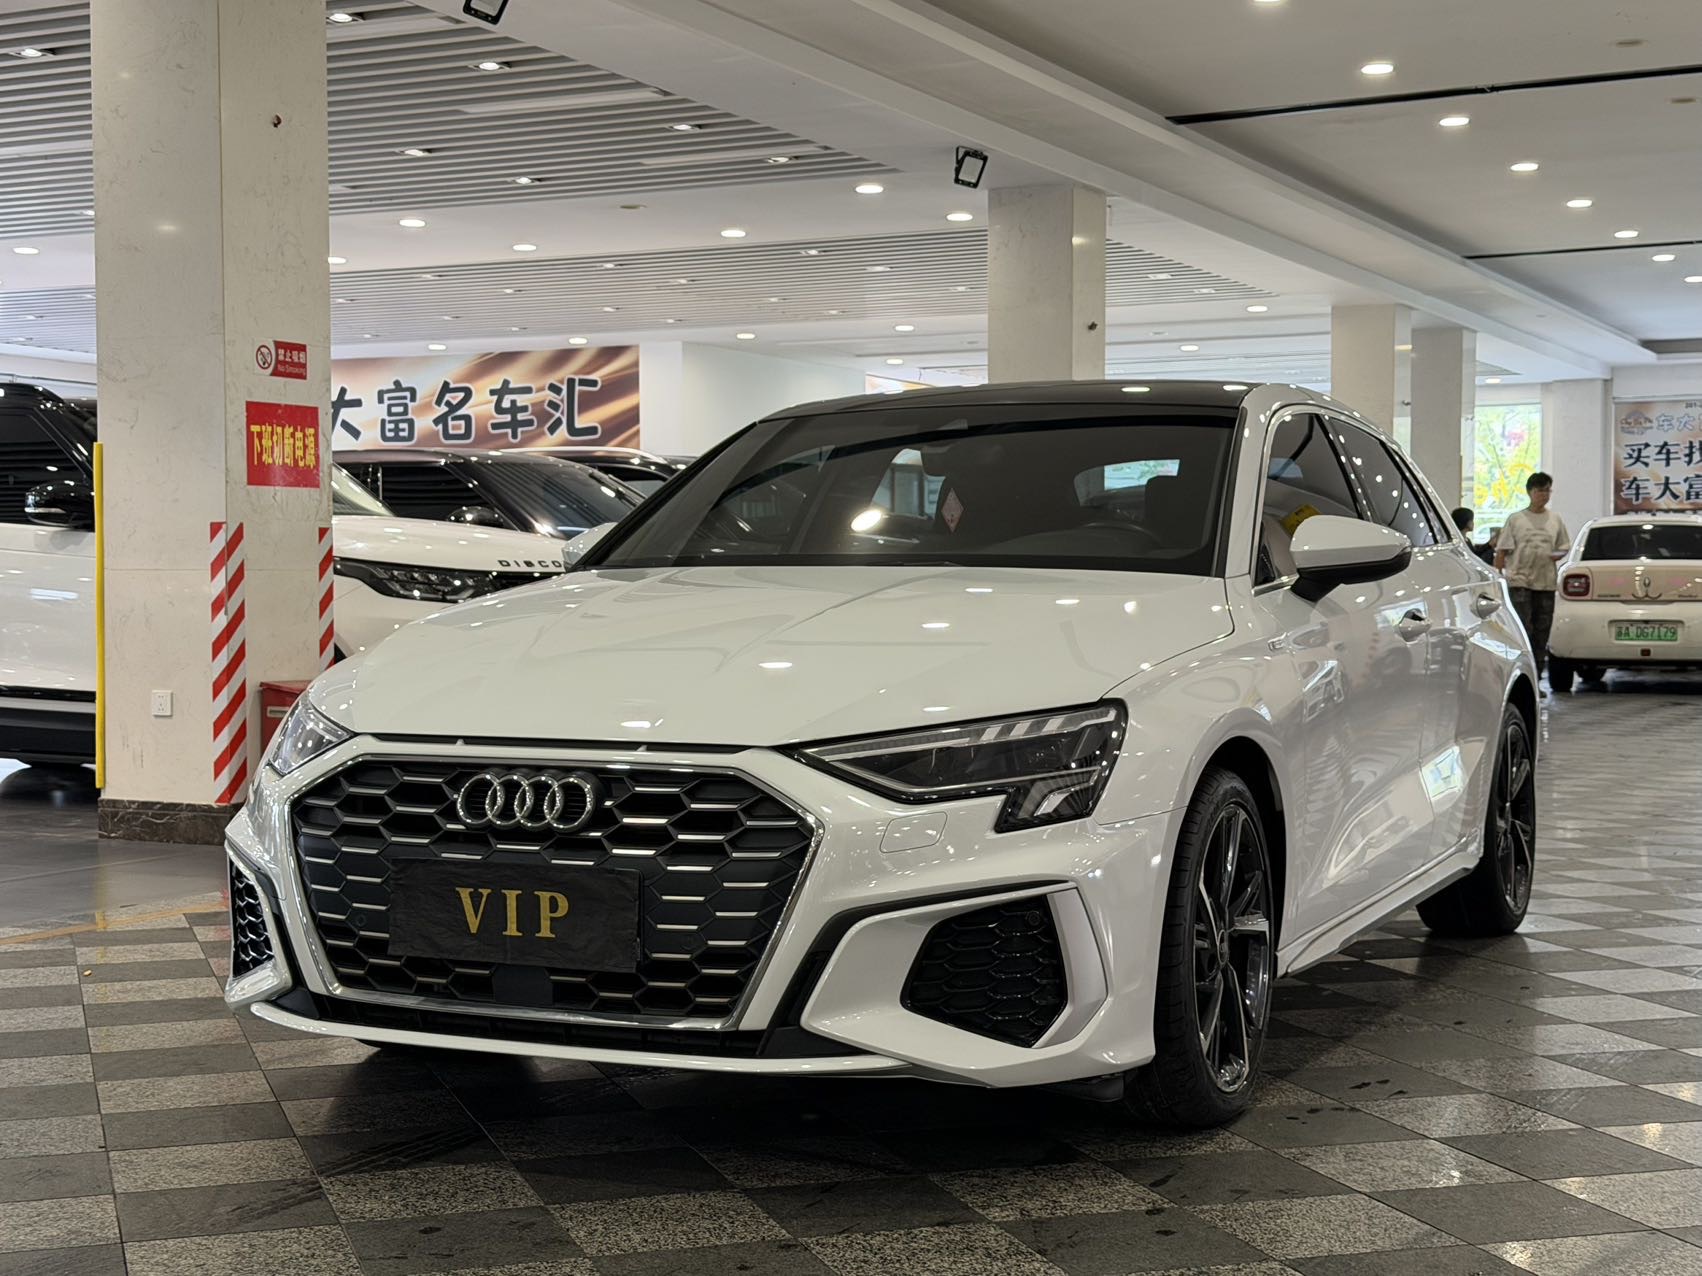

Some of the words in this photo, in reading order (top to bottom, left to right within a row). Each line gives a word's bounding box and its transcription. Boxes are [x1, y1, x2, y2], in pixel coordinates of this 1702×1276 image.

[331, 377, 599, 443] 大富名车汇
[1655, 413, 1702, 432] 车大
[250, 423, 316, 469] 下班切断电源
[455, 887, 569, 938] VIP
